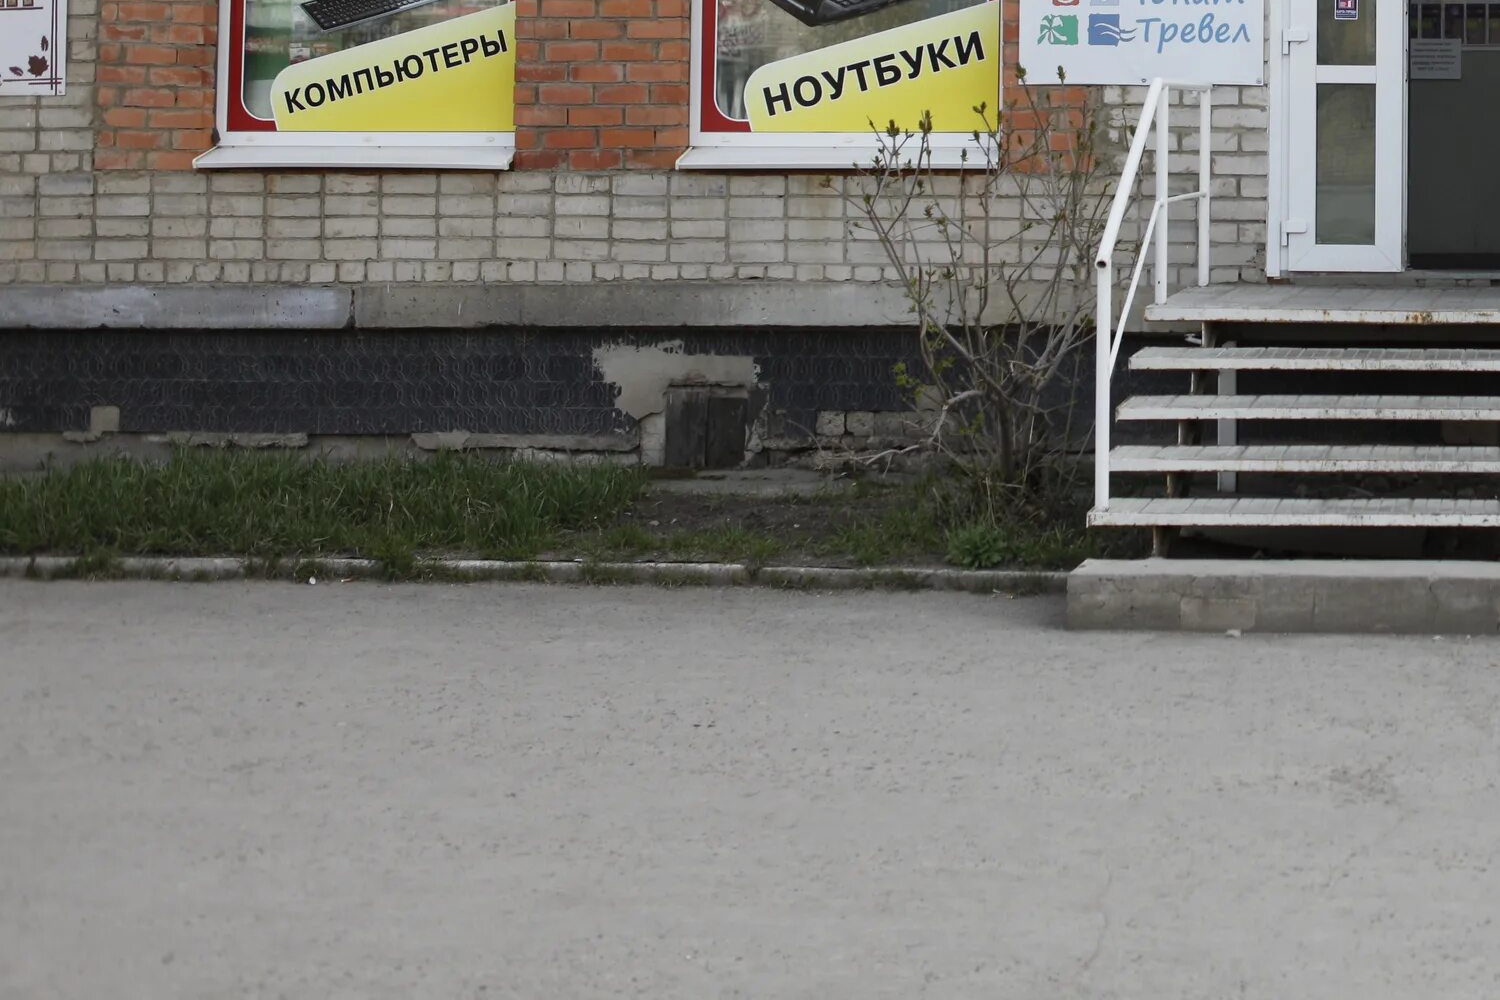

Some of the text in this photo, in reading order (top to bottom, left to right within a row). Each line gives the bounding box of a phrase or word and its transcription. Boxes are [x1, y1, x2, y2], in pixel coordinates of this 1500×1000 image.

[283, 28, 509, 114] КОМПЬЮТЕРЫ
[762, 30, 986, 117] НОУТБУКИ
[1136, 11, 1251, 54] Тревел
